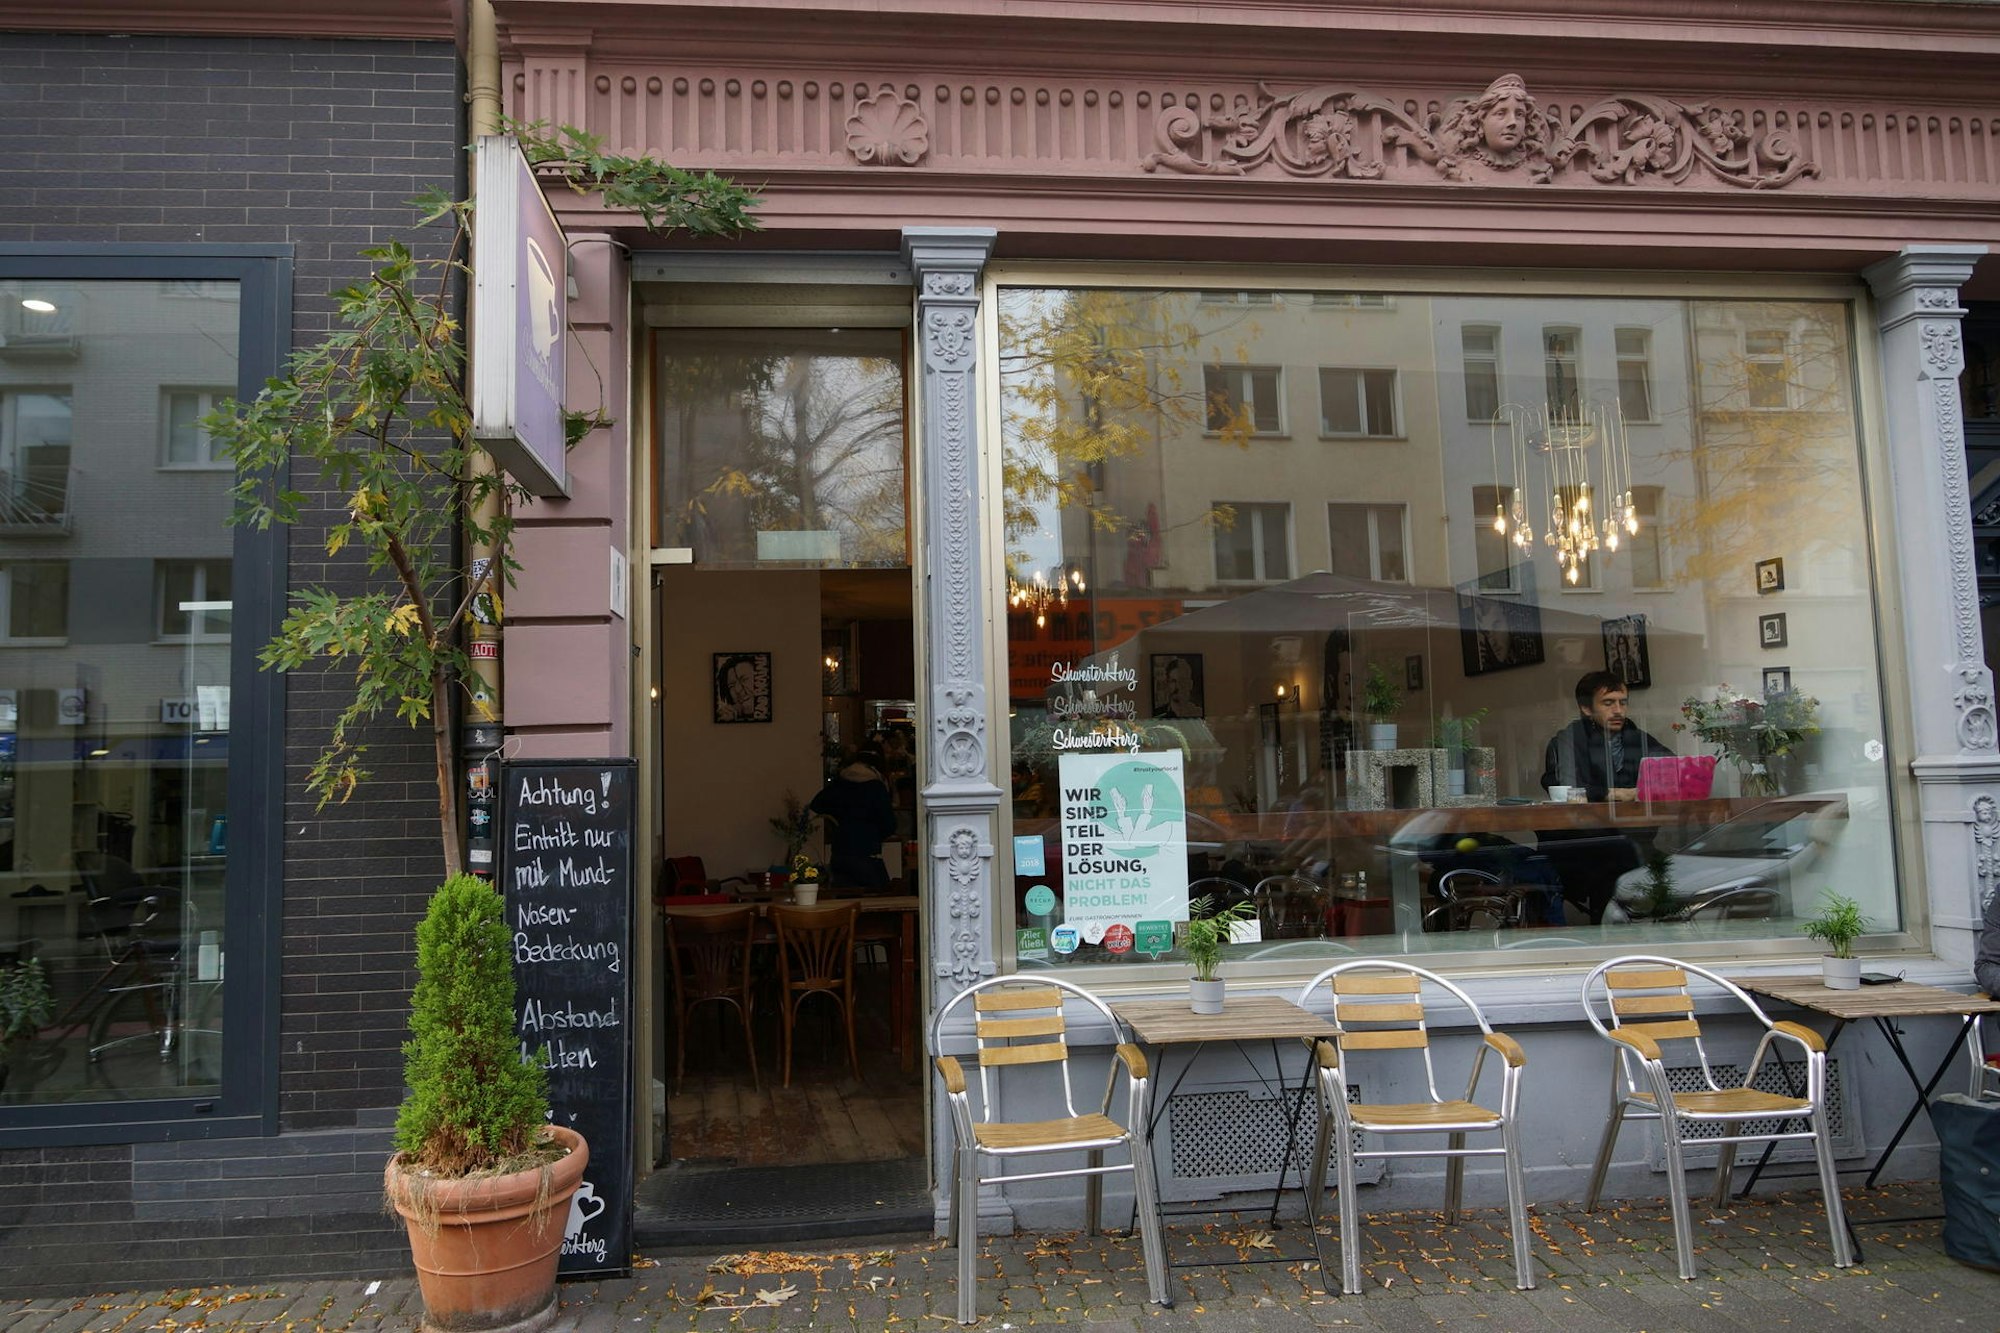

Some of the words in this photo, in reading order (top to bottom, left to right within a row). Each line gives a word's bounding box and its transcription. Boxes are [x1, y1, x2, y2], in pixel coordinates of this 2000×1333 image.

[1051, 662, 1138, 691] SchwesterHerz
[1053, 727, 1140, 755] SchwesterHerz
[1065, 788, 1102, 801] WIR
[1066, 806, 1108, 820] SIND
[515, 822, 579, 851] Eintritt
[584, 829, 614, 849] nur
[1066, 825, 1105, 838] TEIL
[1067, 843, 1104, 857] DER
[515, 856, 550, 890] mit
[559, 855, 615, 887] Mund-
[1068, 858, 1147, 875] LÖSUNG,
[1069, 879, 1116, 891] NICHT
[1120, 877, 1151, 889] DAS
[1069, 894, 1148, 907] PROBLEM!
[518, 901, 578, 930] Nasen-
[513, 931, 621, 973] Bedeckung
[522, 997, 620, 1032] Abstand
[521, 1039, 598, 1069] hlten
